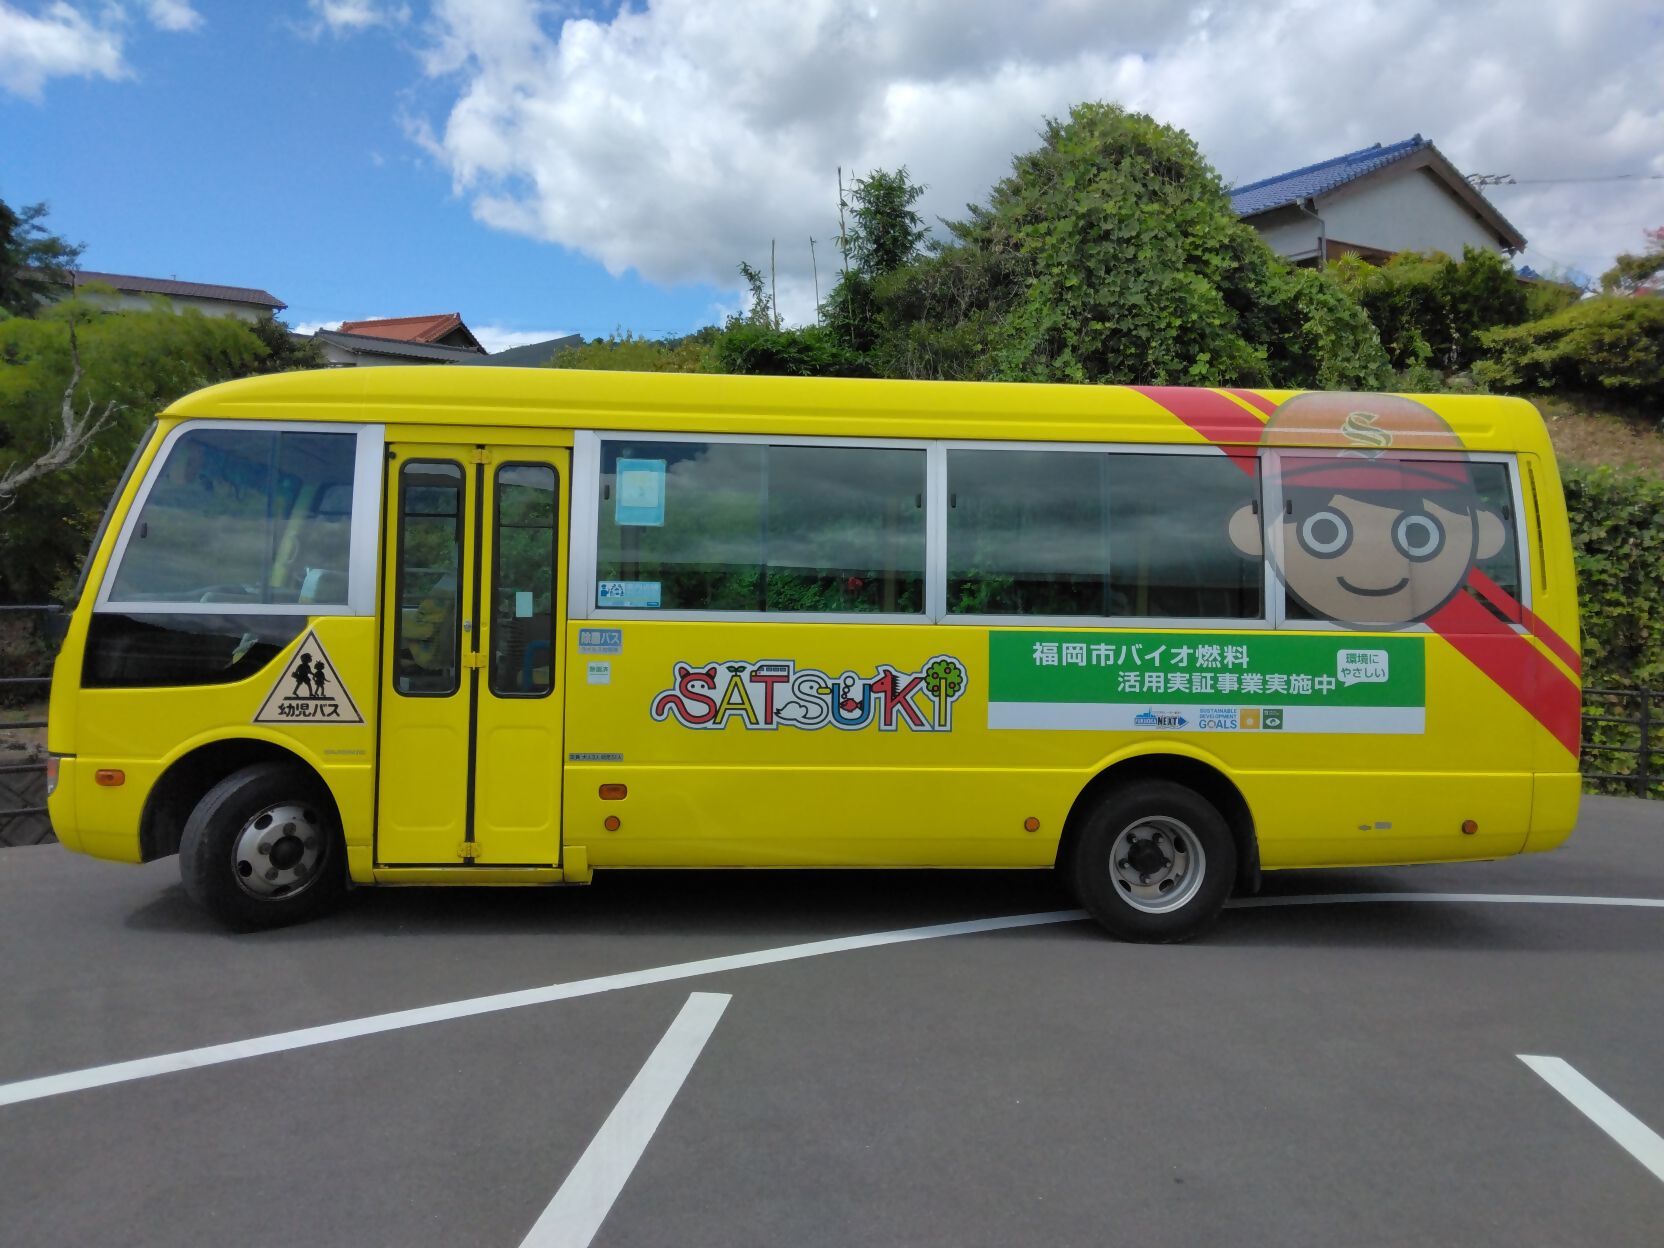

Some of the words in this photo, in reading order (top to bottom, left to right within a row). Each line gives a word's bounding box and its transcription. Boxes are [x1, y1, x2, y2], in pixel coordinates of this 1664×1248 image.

[1032, 641, 1250, 668] 福岡市バイオ燃料
[1345, 652, 1380, 665] 環境に
[1340, 667, 1386, 678] やさしい
[1117, 671, 1336, 695] 活用実証事業実施中
[655, 659, 963, 727] SATSUKI
[277, 702, 341, 718] 幼児バス
[1157, 716, 1178, 726] NEXT
[1198, 719, 1238, 730] GOALS
